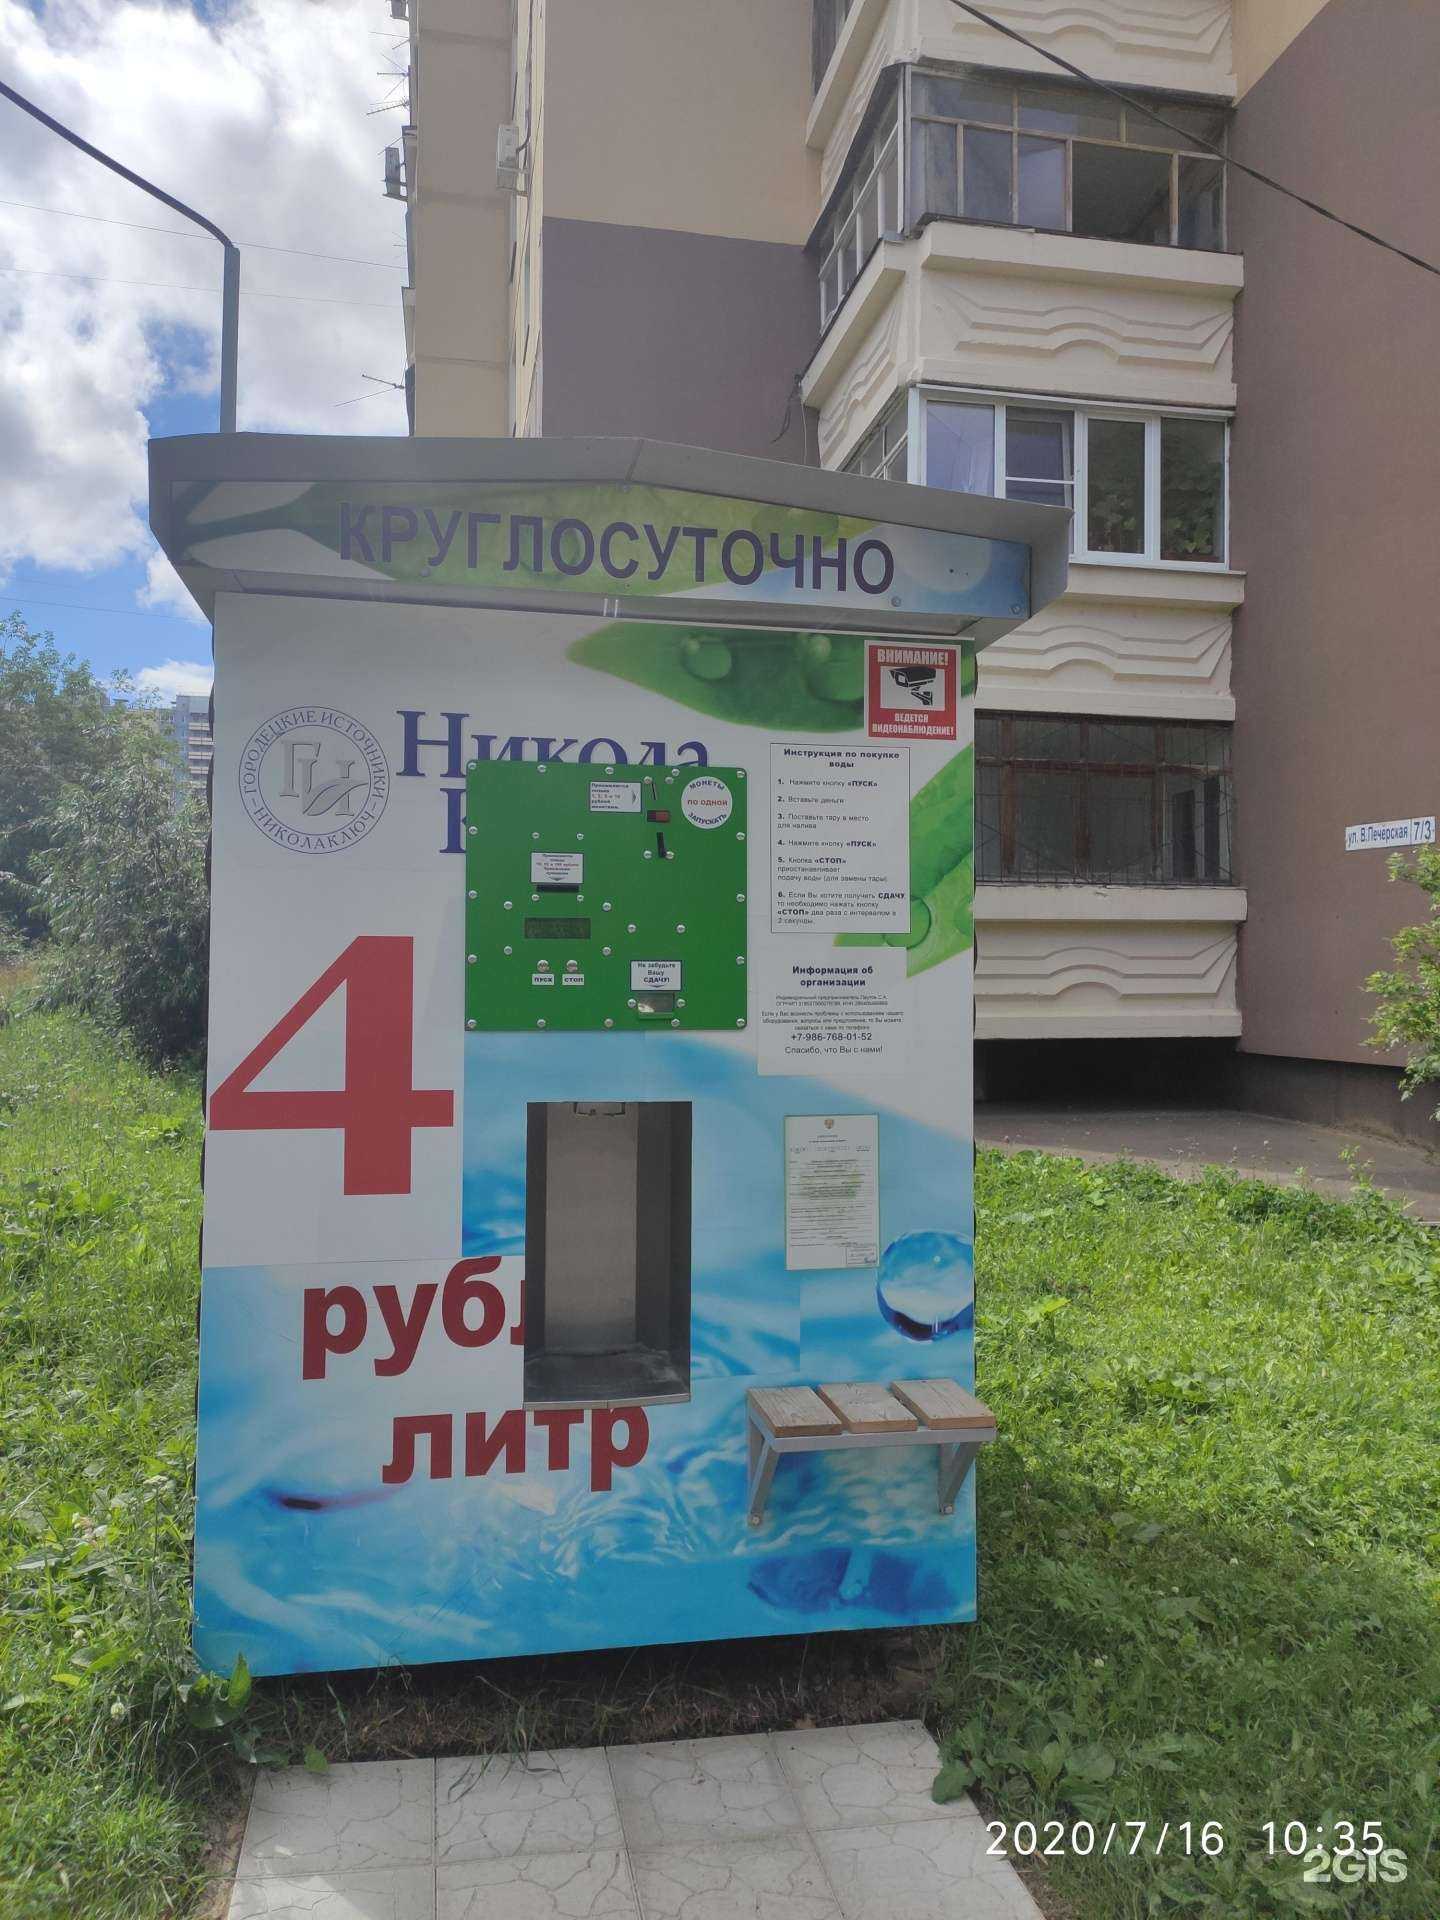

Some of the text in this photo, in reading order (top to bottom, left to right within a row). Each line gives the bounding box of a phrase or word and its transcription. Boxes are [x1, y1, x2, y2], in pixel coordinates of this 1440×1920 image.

[339, 502, 895, 595] КРУГЛОСУТОЧНО
[877, 648, 949, 665] ВНИМАНИЕ!
[894, 713, 929, 723] ВЕДЕТСЯ
[872, 723, 954, 736] ВИДЕОНАБЛЮДЕНИЕ!
[243, 711, 386, 799] ГОРОДЕЦКИЕ ИСТОЧНИКИ
[783, 748, 842, 758] Инструкция
[689, 780, 725, 791] МОНЕТЫ
[687, 812, 728, 825] ЗАПУСКАТЬ
[1347, 831, 1359, 848] ул.
[1413, 820, 1432, 840] 7/3
[792, 965, 874, 976] Информация об
[799, 978, 866, 988] организации
[790, 1032, 873, 1042] +7-986-768-01-52
[784, 1045, 823, 1055] Спасибо,
[825, 1046, 838, 1054] что
[209, 935, 454, 1195] 4
[382, 1405, 650, 1493] литр
